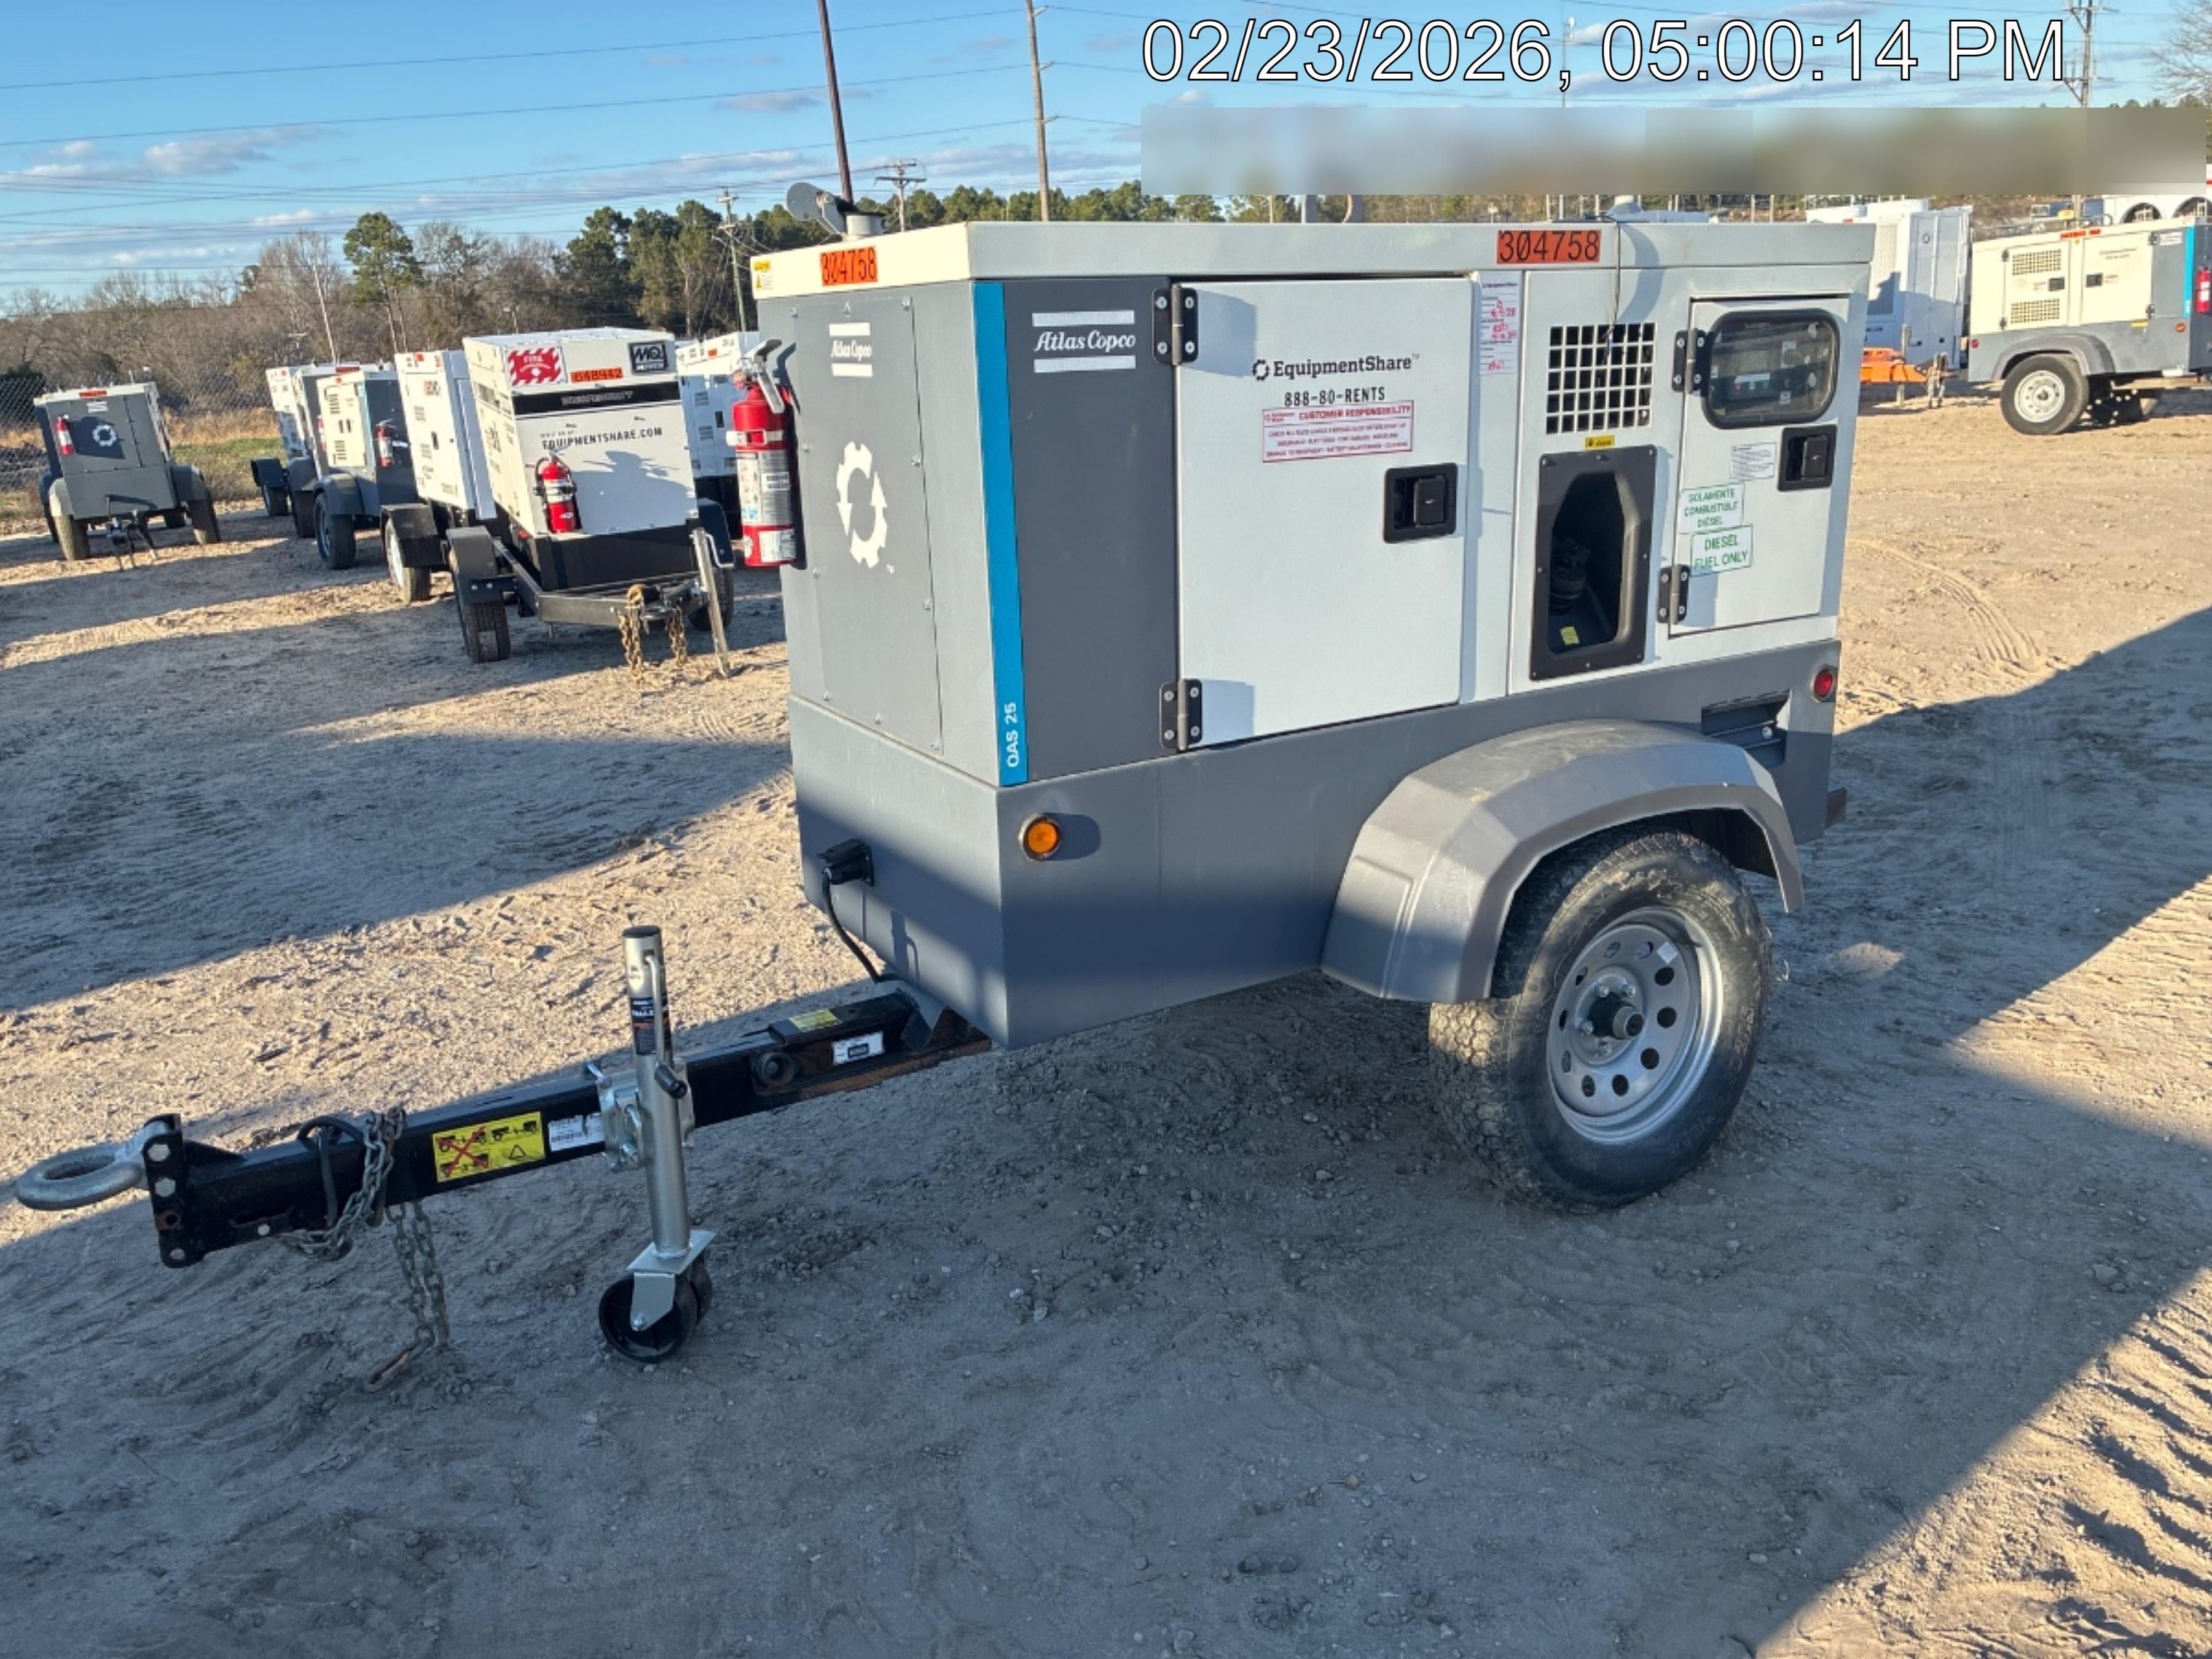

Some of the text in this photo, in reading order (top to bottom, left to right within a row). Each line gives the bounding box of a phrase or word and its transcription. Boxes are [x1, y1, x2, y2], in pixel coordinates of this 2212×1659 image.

[1499, 230, 1599, 263] 304758
[822, 246, 877, 284] 304758
[1033, 329, 1136, 353] Atlas Copco
[1273, 355, 1412, 380] EquipmentShare
[1284, 386, 1386, 407] 888-80-RENTS
[1299, 409, 1344, 420] CUSTOMER
[1688, 488, 1735, 503] SOLAMENTE
[1704, 534, 1738, 551] DIESEL
[1722, 549, 1748, 565] ONLY
[1003, 702, 1020, 768] QAS 25
